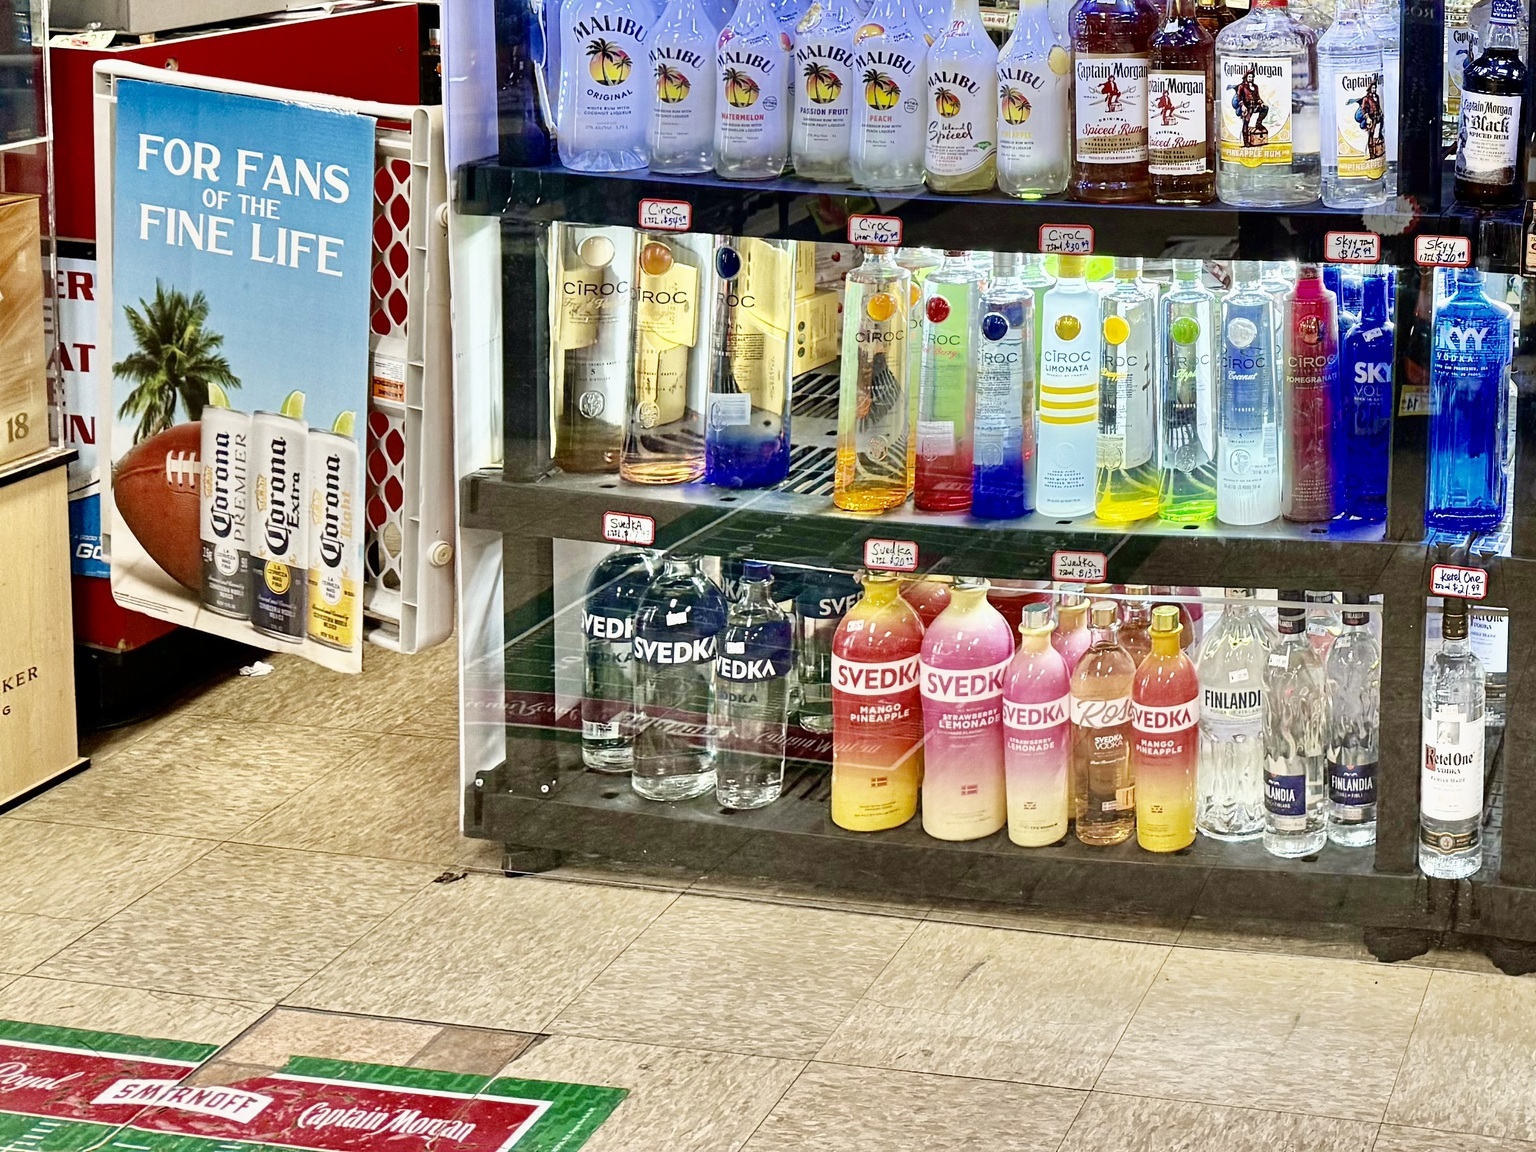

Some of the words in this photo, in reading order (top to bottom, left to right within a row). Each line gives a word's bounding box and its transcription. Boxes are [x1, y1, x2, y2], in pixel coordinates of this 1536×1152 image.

[575, 13, 648, 44] MALIBU
[717, 52, 773, 73] MALIBU
[856, 51, 916, 73] MALIBU
[1076, 61, 1108, 80] Captain
[1110, 59, 1148, 80] Morgan
[1223, 61, 1248, 78] Captain
[1252, 63, 1283, 78] Morgan
[587, 89, 634, 100] ORIGINAL
[800, 108, 826, 116] PASSION
[827, 107, 848, 115] FRUIT
[1082, 122, 1113, 135] Spiced
[1117, 122, 1142, 134] Rum
[1470, 115, 1509, 133] Black
[138, 133, 220, 182] FOR
[236, 148, 350, 204] FANS
[202, 188, 230, 210] OF
[238, 194, 280, 220] THE
[139, 203, 236, 257] FINE
[250, 225, 345, 277] LIFE
[1045, 363, 1089, 372] LIMONATA
[1437, 353, 1474, 362] VODKA
[7, 413, 29, 440] 18
[210, 432, 231, 538] Corona
[233, 433, 247, 544] PREMIER
[265, 437, 289, 557] Corona
[287, 471, 301, 530] Extra
[320, 454, 343, 567] Corona
[850, 708, 909, 722] PINEAPPLE
[860, 704, 901, 715] MANGO
[1003, 704, 1064, 726] SVEDKA
[1132, 706, 1191, 728] SVEDKA
[1332, 776, 1373, 791] FINLANDIA
[112, 1080, 257, 1115] SMIRNOFF
[298, 1102, 394, 1134] Captain
[395, 1107, 476, 1141] Morgan
